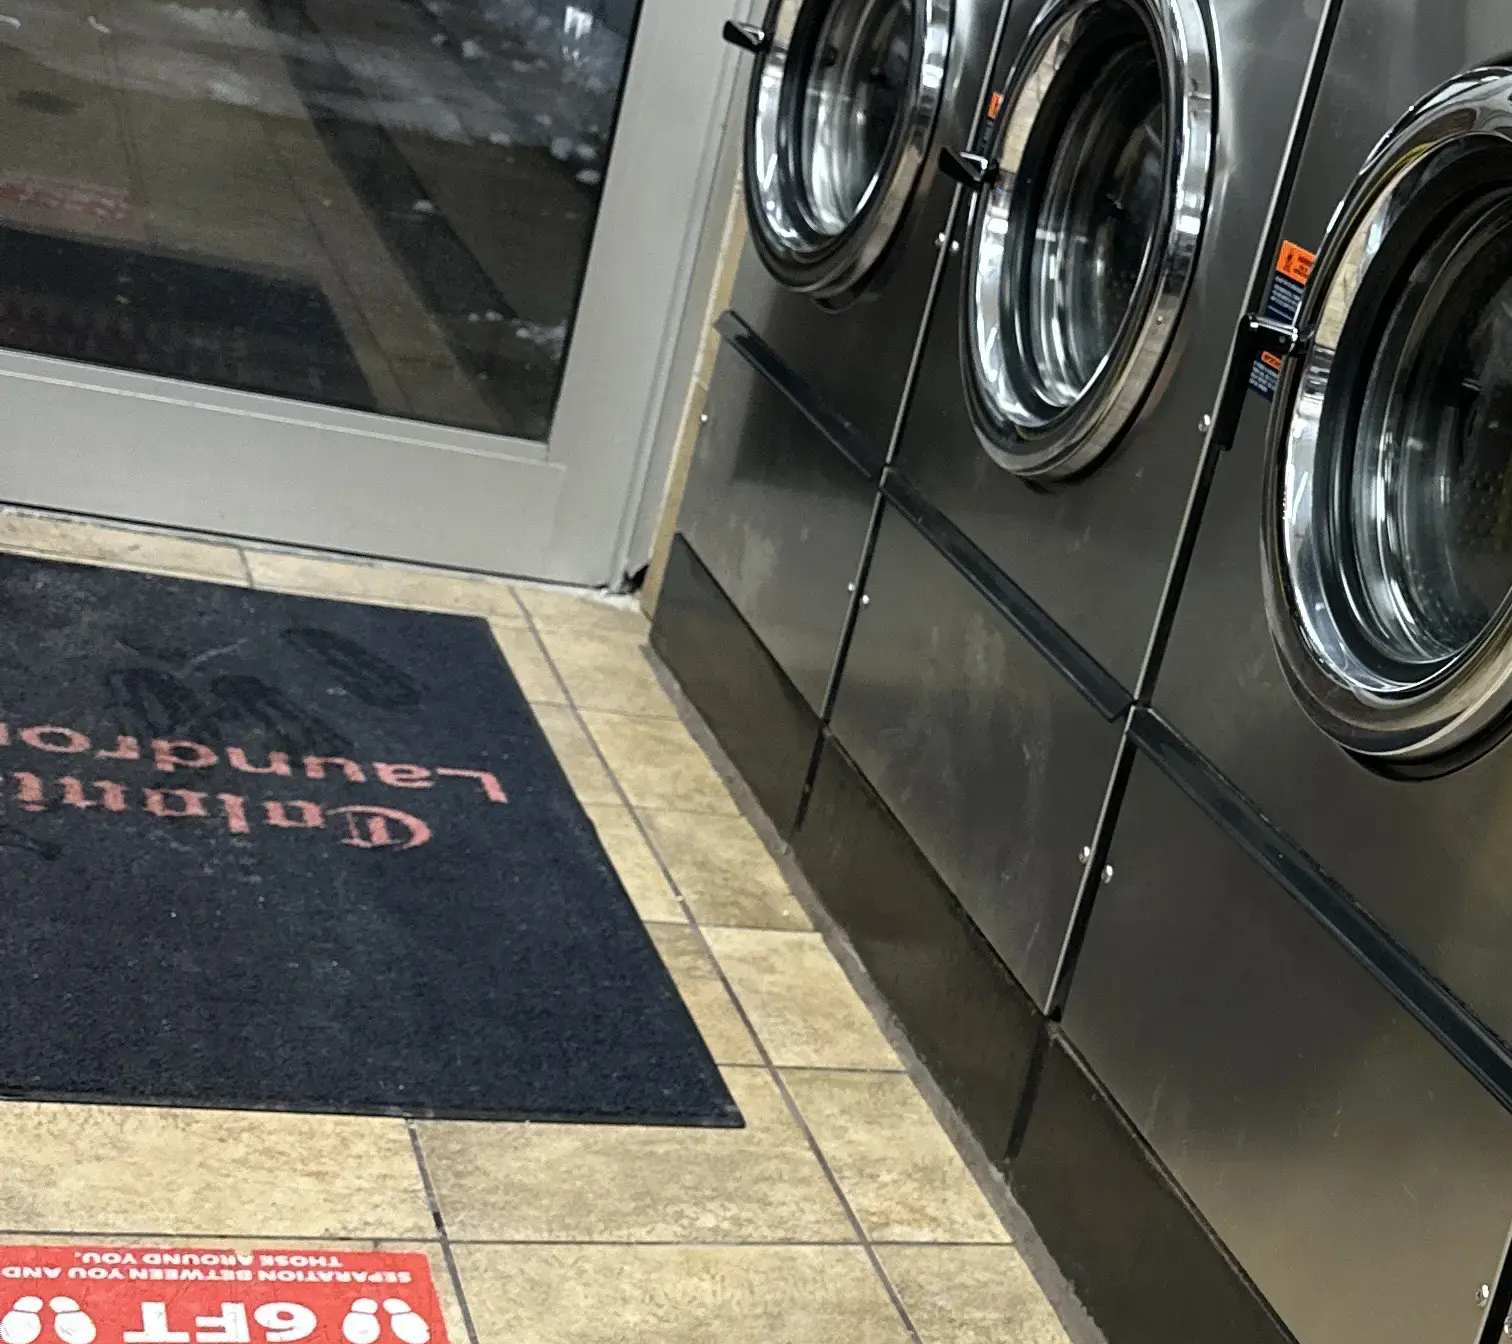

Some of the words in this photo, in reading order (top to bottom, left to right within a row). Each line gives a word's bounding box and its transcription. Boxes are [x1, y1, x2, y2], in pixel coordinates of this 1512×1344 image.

[0, 721, 509, 805] Laundro
[0, 770, 432, 850] Coloni
[74, 1251, 137, 1265] YOU.
[142, 1252, 254, 1267] AROUND
[259, 1254, 344, 1268] THOSE
[0, 1265, 62, 1280] AND
[67, 1266, 125, 1280] YOU
[129, 1267, 253, 1282] BETWEEN
[257, 1268, 413, 1284] SEPARATION
[122, 1300, 318, 1344] 6FT
